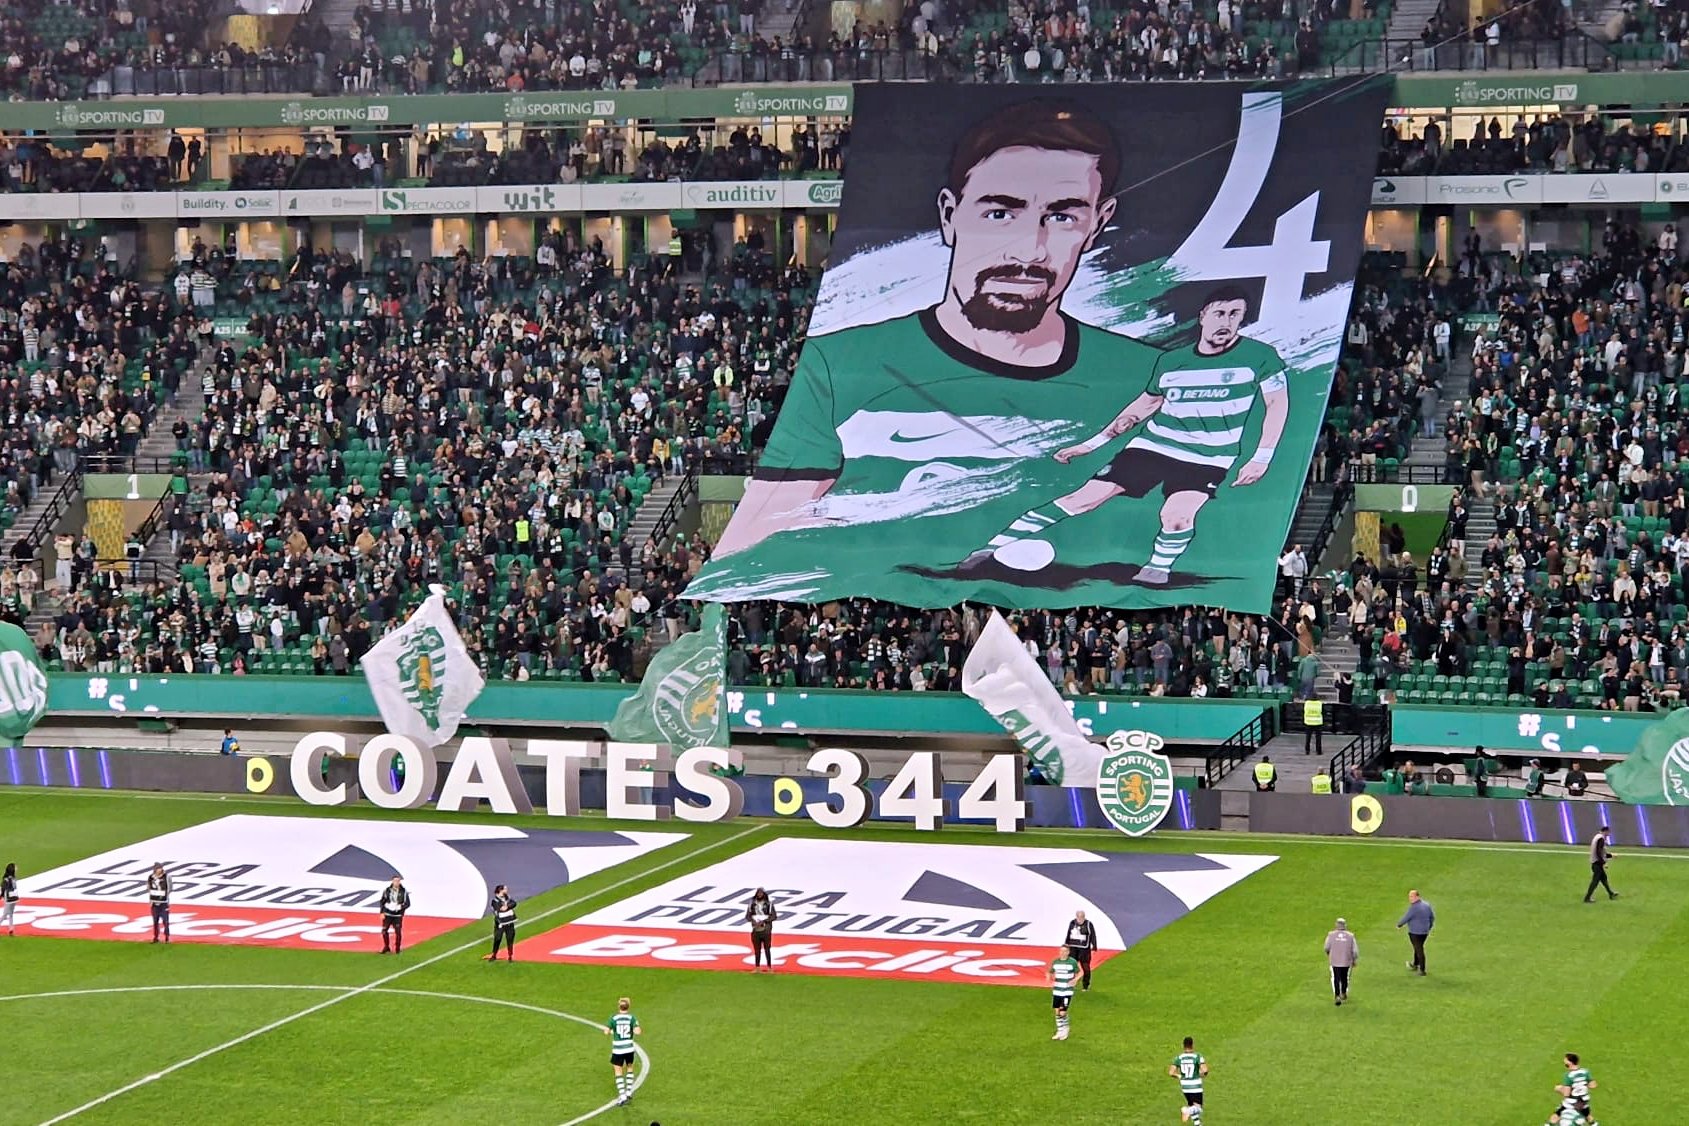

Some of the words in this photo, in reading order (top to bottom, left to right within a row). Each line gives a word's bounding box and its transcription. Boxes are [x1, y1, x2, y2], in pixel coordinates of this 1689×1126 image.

[1479, 86, 1551, 101] SPORTING
[1554, 84, 1577, 100] TV
[528, 102, 591, 116] SPORTING
[594, 100, 615, 115] TV
[757, 98, 823, 111] SPORTING
[826, 96, 847, 110] TV
[80, 111, 141, 123] SPORTING
[144, 110, 164, 123] TV
[304, 108, 365, 121] SPORTING
[369, 106, 388, 120] TV
[504, 187, 556, 210] wit
[707, 185, 776, 202] auditiv
[1158, 91, 1331, 325] 4
[1183, 388, 1230, 399] BETANO
[127, 474, 139, 499] 1
[1109, 733, 1161, 751] SCP
[1105, 755, 1164, 777] SPORTING
[290, 732, 736, 822] COATES
[806, 747, 1026, 832] 344
[1109, 807, 1162, 824] PORTUGAL
[89, 859, 261, 880] LIGA
[672, 886, 847, 909] LIGA
[549, 934, 1046, 977] Betclic
[616, 1024, 631, 1039] 42
[1181, 1063, 1195, 1079] 47
